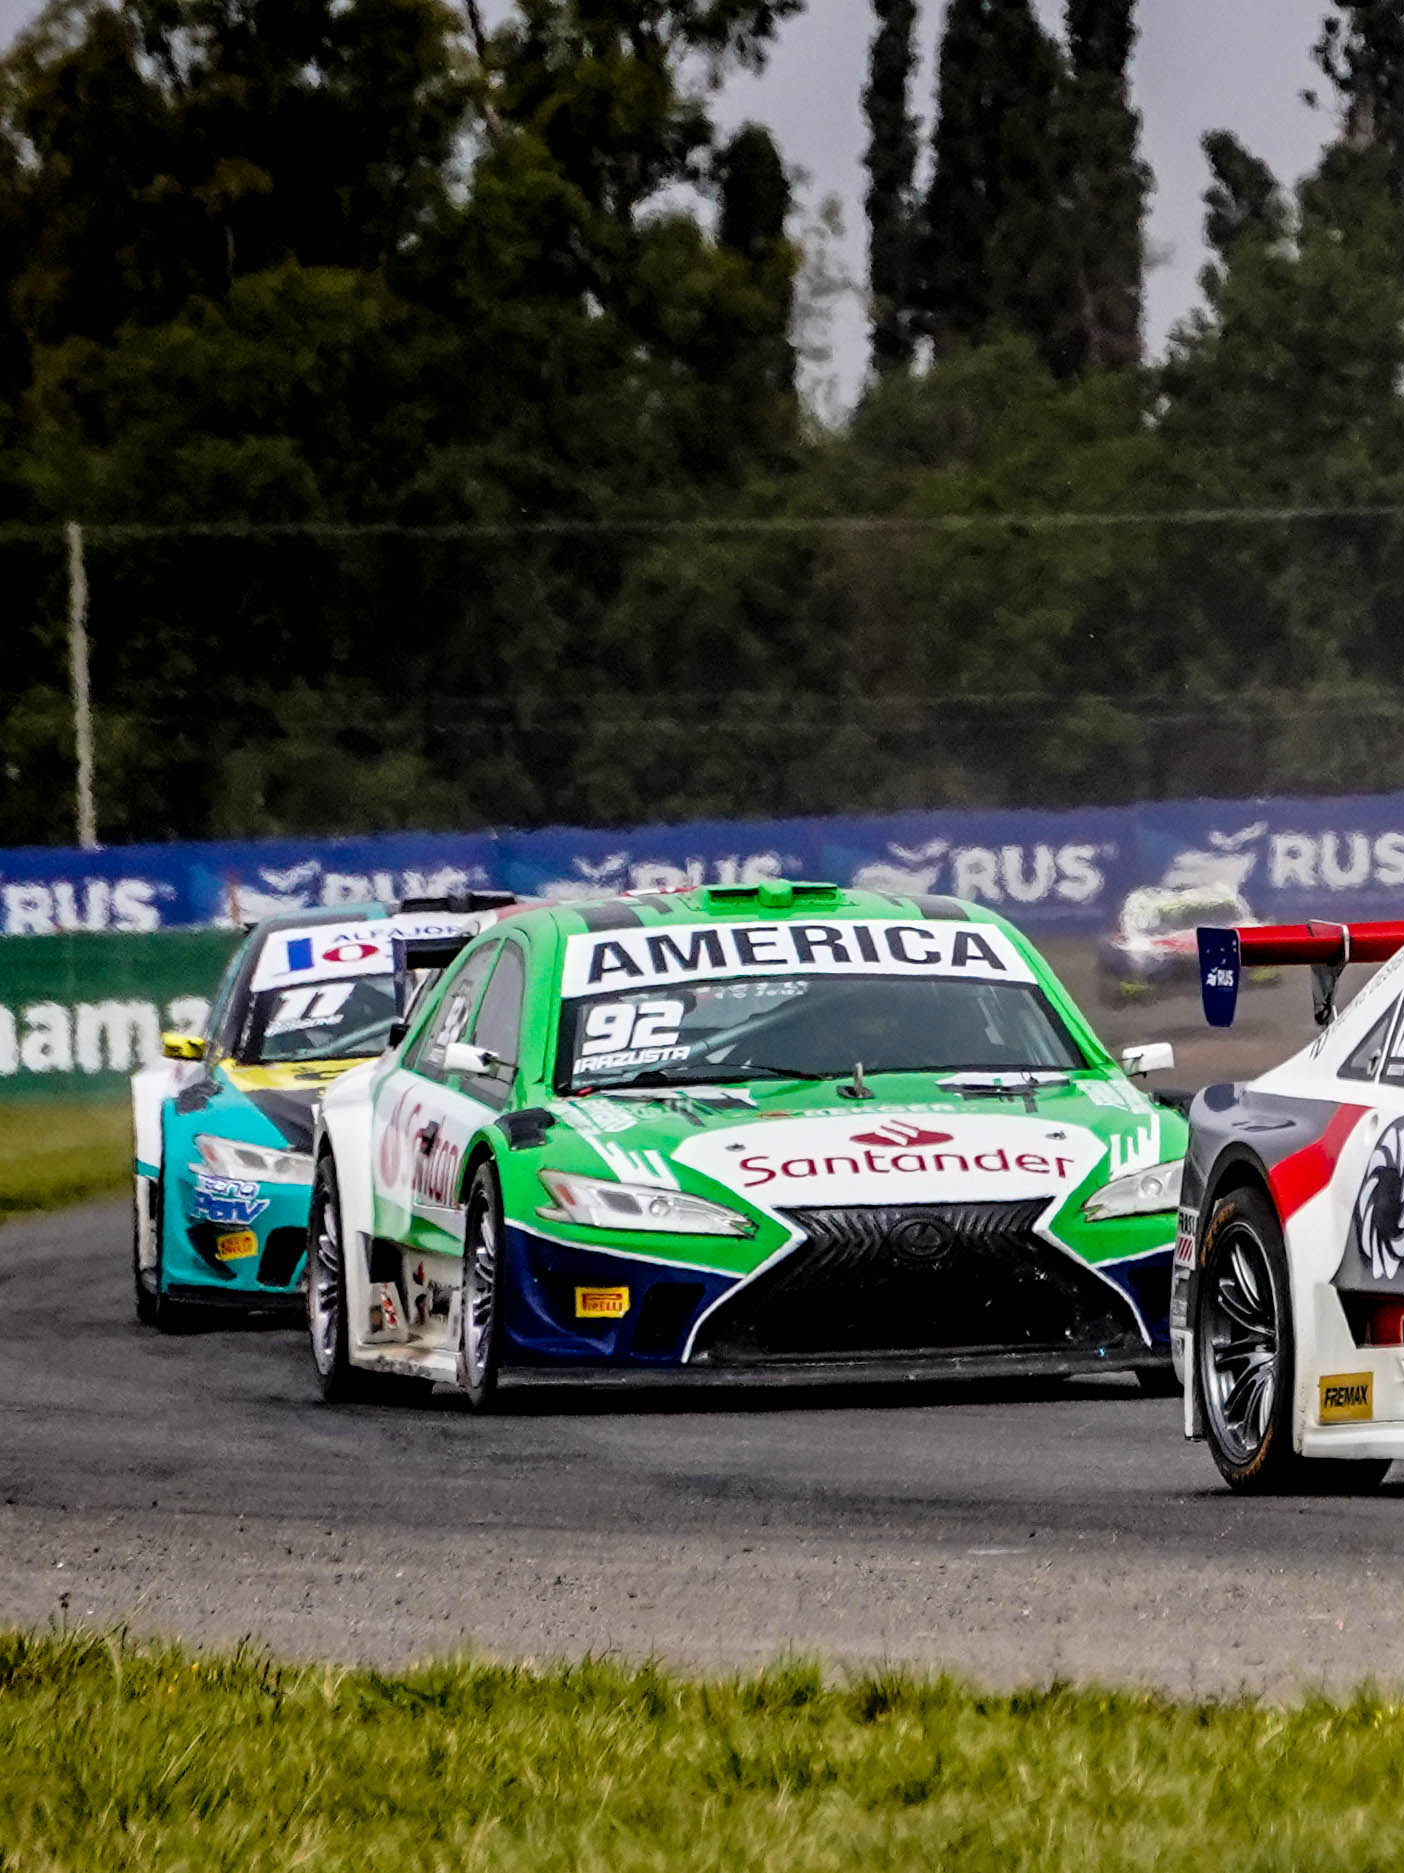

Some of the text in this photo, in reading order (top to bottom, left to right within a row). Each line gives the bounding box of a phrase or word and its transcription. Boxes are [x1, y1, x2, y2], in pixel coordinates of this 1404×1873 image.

[954, 844, 1104, 903] RUS
[2, 877, 162, 934] RUS
[587, 925, 1008, 984] AMERICA
[1217, 969, 1234, 987] RUS
[581, 998, 685, 1056] 92
[572, 1045, 691, 1075] IRAZUSTA
[738, 1148, 1075, 1188] Santander
[1324, 1384, 1369, 1409] FREMAX
